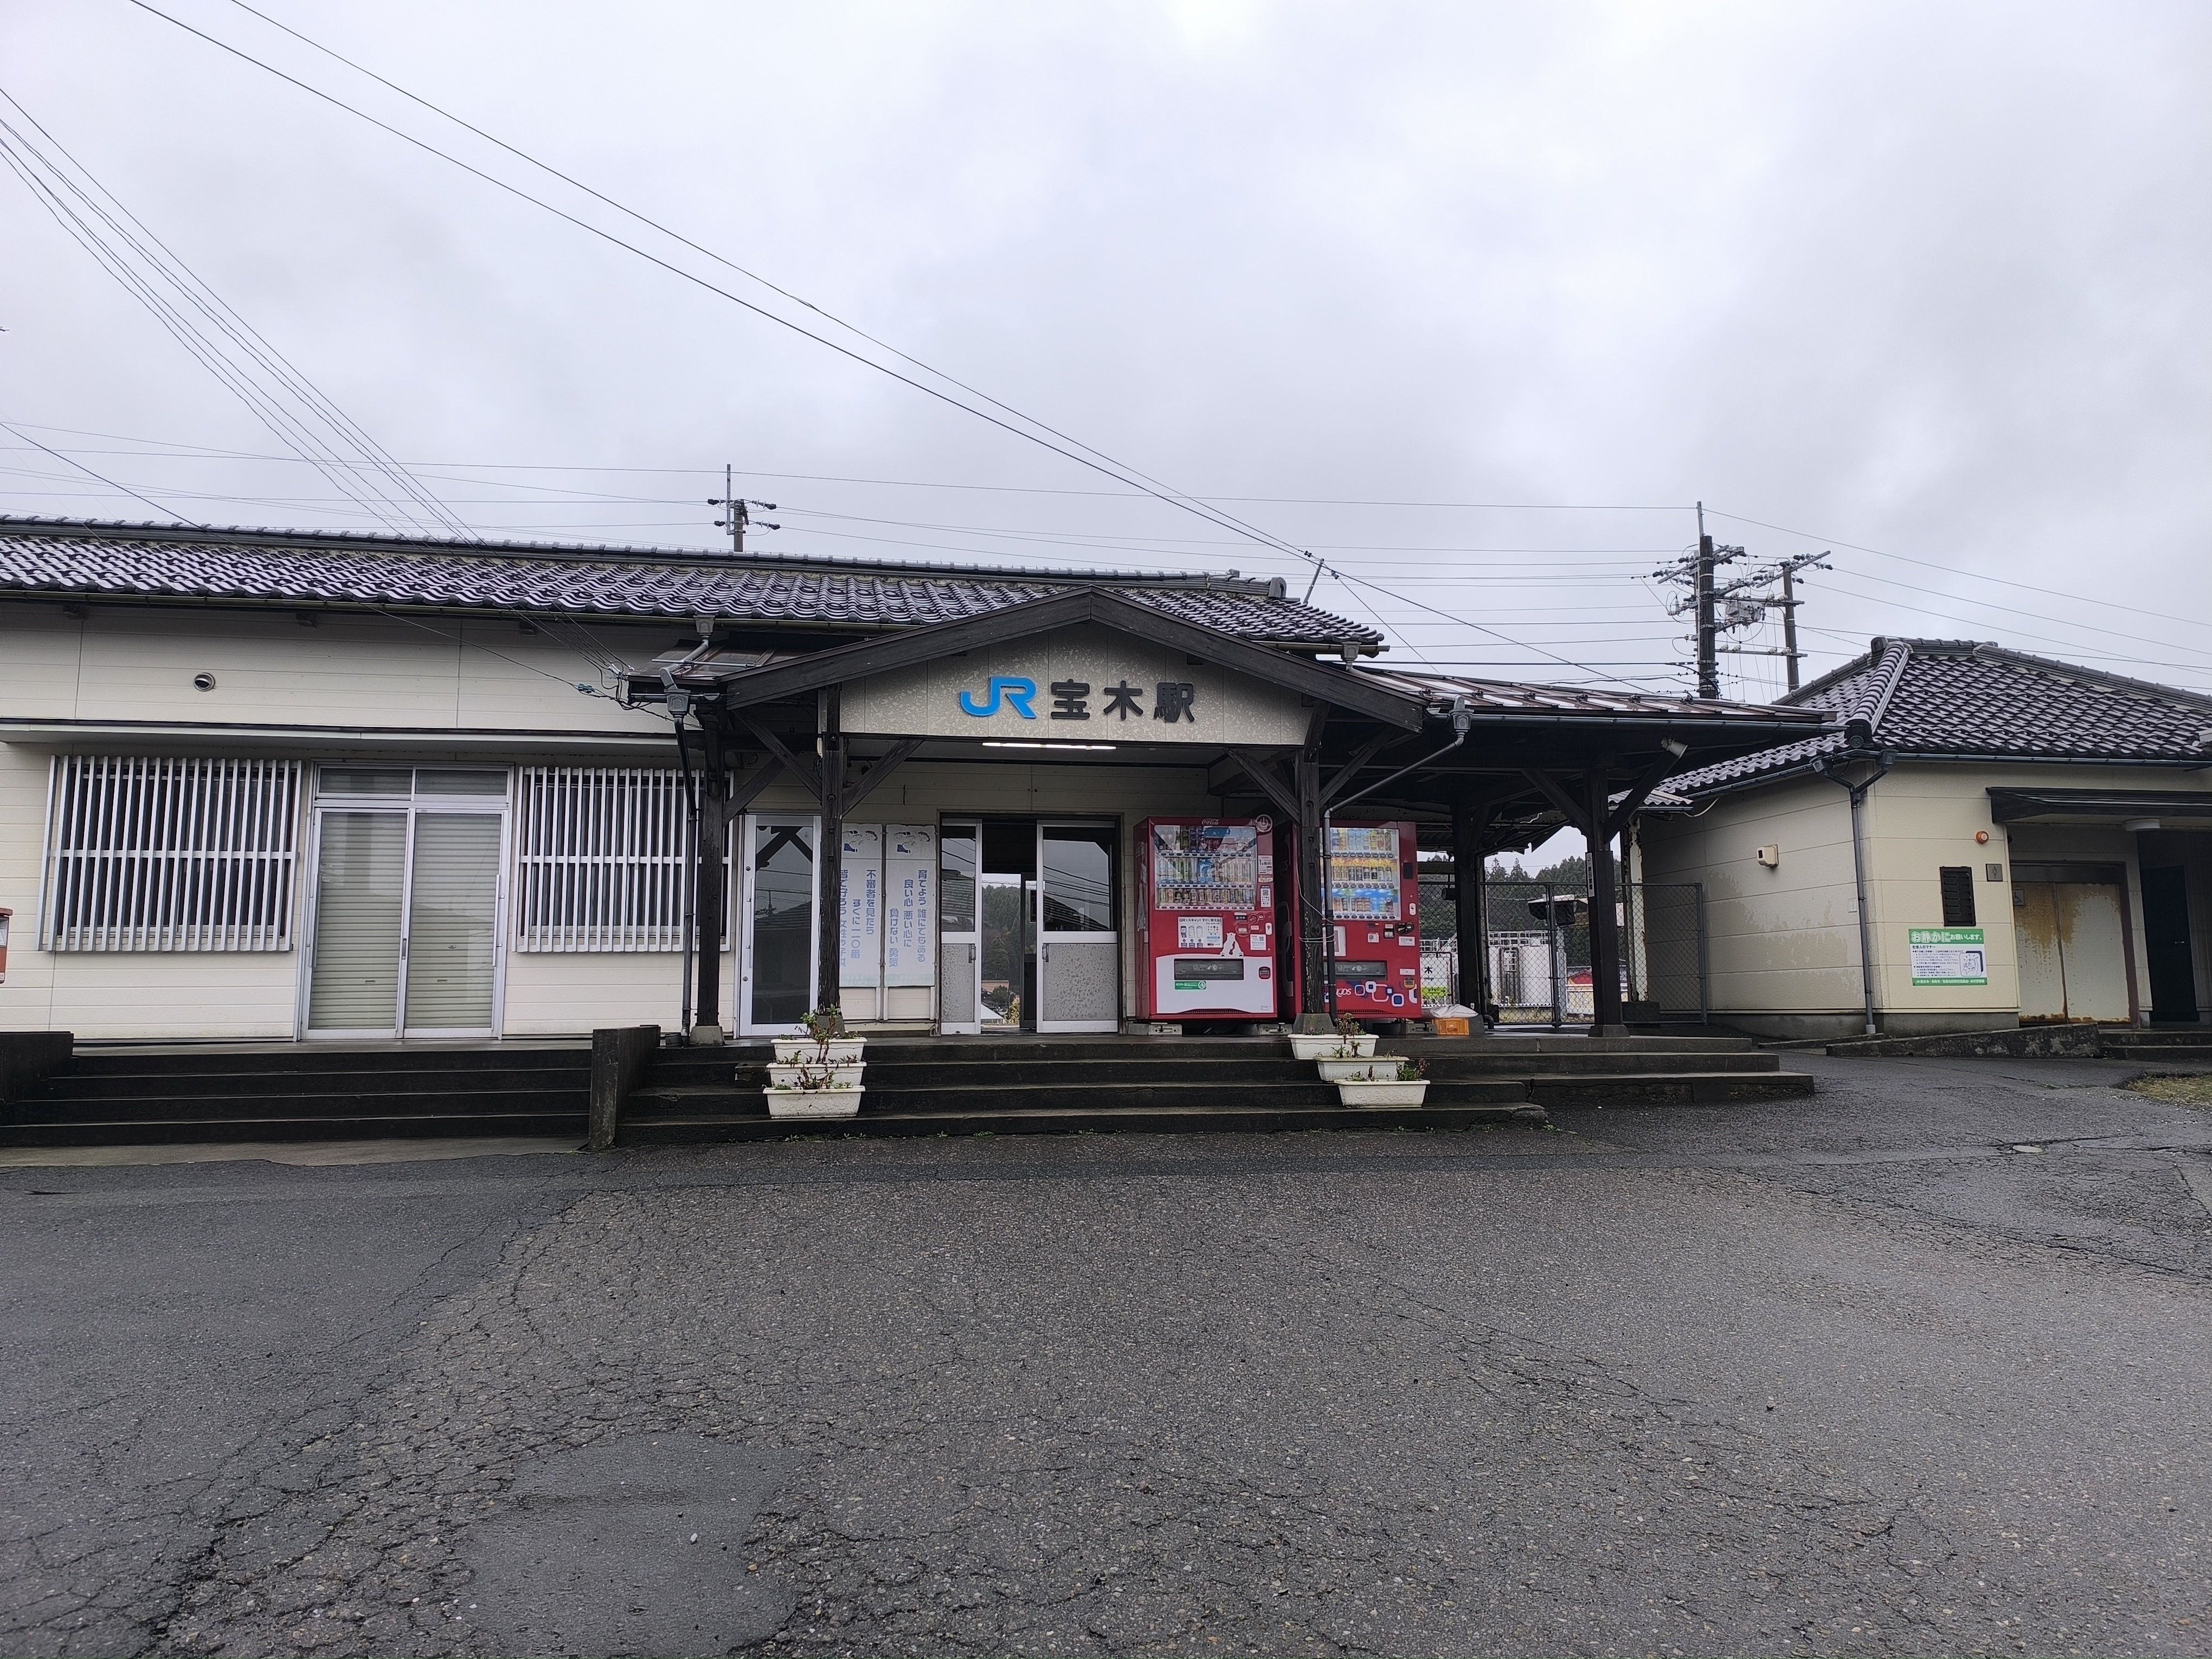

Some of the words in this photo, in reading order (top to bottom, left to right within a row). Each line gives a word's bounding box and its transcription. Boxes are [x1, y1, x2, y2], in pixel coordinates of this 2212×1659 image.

[960, 677, 1037, 718] JR
[1050, 678, 1195, 723] 宝木駅
[866, 870, 876, 935] 不審者を見たら
[904, 879, 914, 907] 良い心
[918, 870, 928, 905] 育てよう
[890, 908, 899, 944] 負けない
[903, 910, 913, 947] 悪い心に
[917, 909, 927, 962] 誰にでもある
[889, 948, 898, 967] 勇気
